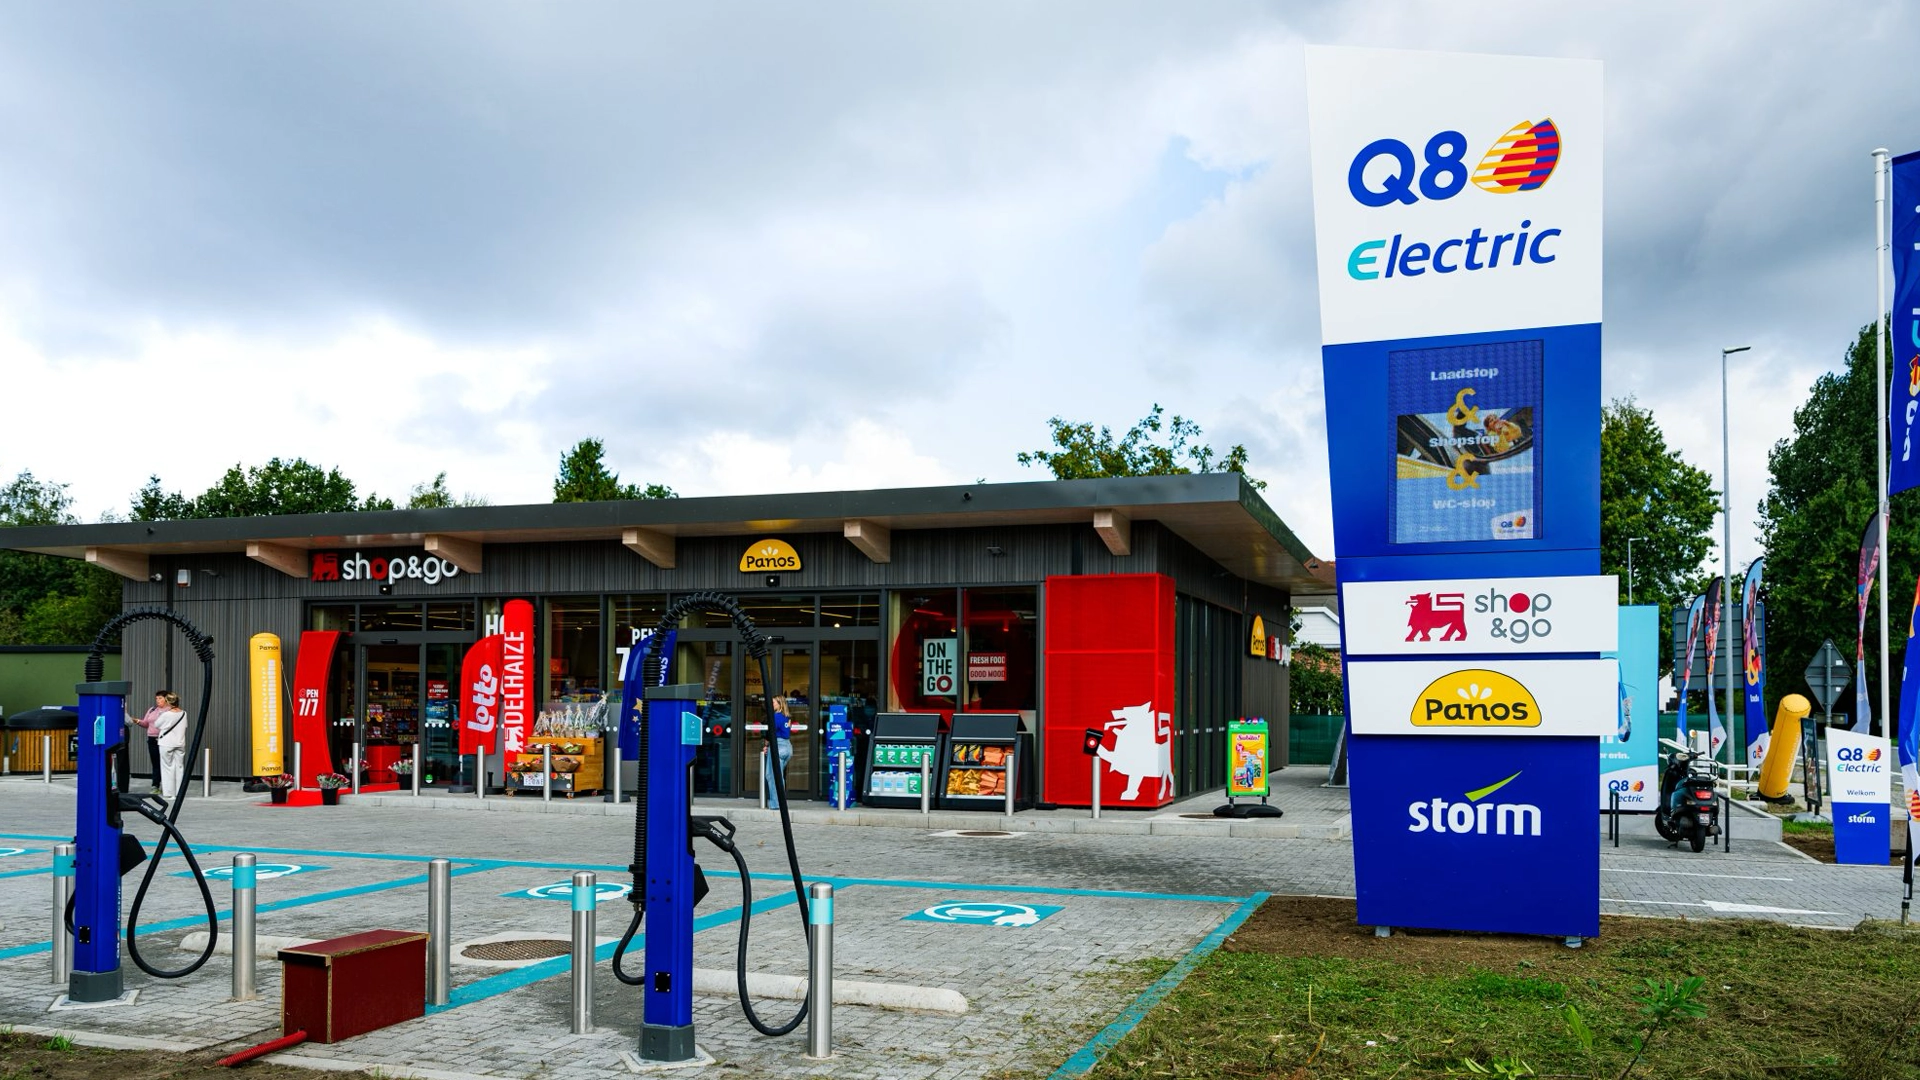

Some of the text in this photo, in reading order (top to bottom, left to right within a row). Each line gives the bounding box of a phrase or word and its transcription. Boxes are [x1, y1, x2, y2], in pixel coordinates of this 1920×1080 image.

[1348, 130, 1468, 207] Q8
[1347, 219, 1562, 281] Electric
[1430, 367, 1499, 382] Laadstop
[1446, 387, 1480, 426] &
[1428, 434, 1500, 449] Shopstop
[1446, 452, 1480, 490] &
[1432, 498, 1496, 510] WC-stop
[342, 551, 459, 585] shop&go
[746, 556, 795, 568] Panos
[1474, 587, 1552, 618] shop
[1490, 617, 1552, 644] &go
[927, 642, 946, 658] ON
[927, 659, 952, 675] THE
[970, 656, 1005, 664] FRESH FOOD
[503, 631, 525, 725] DELHAIZE
[970, 670, 1005, 678] GOOD MOOD
[927, 675, 953, 693] GO
[299, 688, 319, 698] OPEN
[466, 664, 498, 733] Lotto
[299, 698, 319, 716] 7/7
[1425, 698, 1529, 722] Panos
[1837, 747, 1863, 762] Q8
[1837, 763, 1882, 773] Electric
[1608, 780, 1629, 792] Q8
[1407, 797, 1542, 836] storm
[1848, 814, 1876, 824] storm
